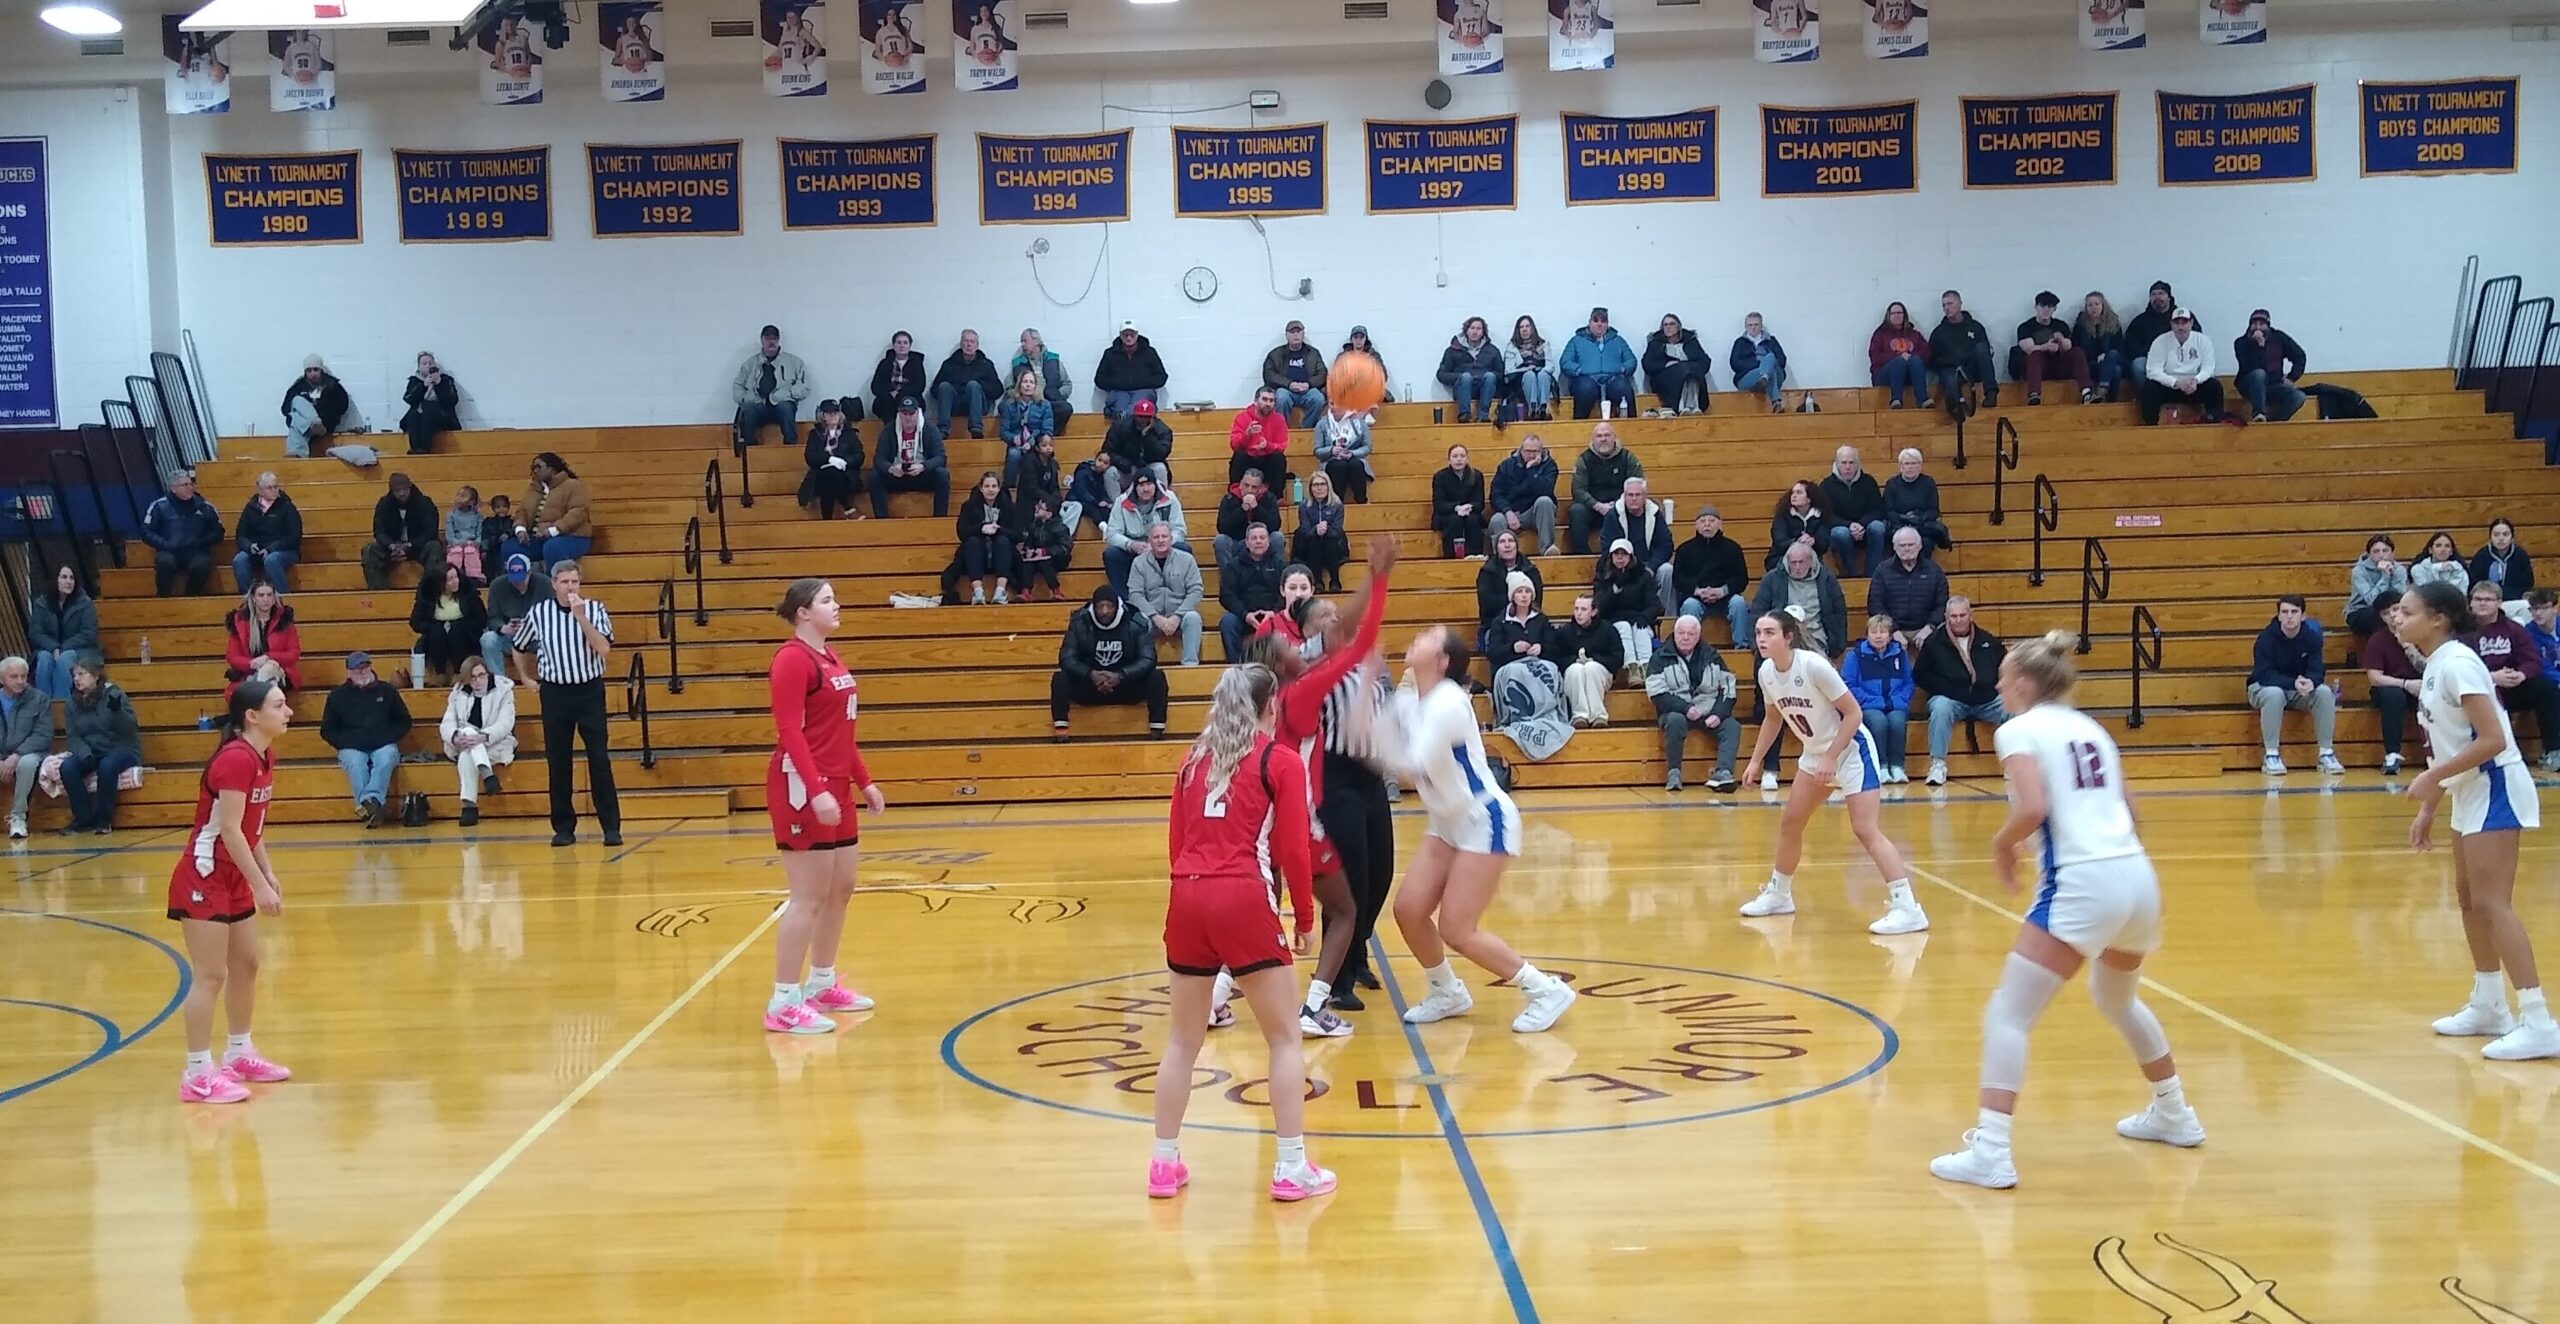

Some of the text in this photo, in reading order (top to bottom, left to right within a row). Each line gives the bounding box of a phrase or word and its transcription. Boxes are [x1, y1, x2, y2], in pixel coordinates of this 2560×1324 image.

[987, 68, 1006, 77] WALSH
[2169, 100, 2303, 120] LYNETT TOURNAMENT
[2373, 91, 2505, 111] LYNETT TOURNAMENT
[1973, 104, 2103, 124] LYNETT TOURNAMENT
[1573, 121, 1704, 140] LYNETT TOURNAMENT
[1772, 114, 1905, 134] LYNETT TOURNAMENT
[2379, 117, 2499, 137] BOYS CHAMPIONS
[1183, 136, 1313, 155] LYNETT TOURNAMENT
[1375, 128, 1506, 148] LYNETT TOURNAMENT
[1980, 131, 2100, 150] CHAMPIONS
[2176, 126, 2298, 146] GIRLS CHAMPIONS
[788, 146, 923, 167] LYNETT TOURNAMENT
[990, 143, 1116, 163] LYNETT TOURNAMENT
[1581, 146, 1701, 166] CHAMPIONS
[1779, 139, 1899, 159] CHAMPIONS
[2418, 143, 2464, 161] 2009
[401, 157, 542, 178] LYNETT TOURNAMENT
[595, 153, 732, 171] LYNETT TOURNAMENT
[1190, 160, 1310, 179] CHAMPIONS
[1381, 154, 1502, 174] CHAMPIONS
[2016, 158, 2063, 175] 2002
[2215, 154, 2261, 172] 2008
[216, 163, 346, 182] LYNETT TOURNAMENT
[996, 167, 1113, 187] CHAMPIONS
[1619, 173, 1664, 190] 1999
[1817, 166, 1861, 184] 2001
[604, 180, 728, 198] CHAMPIONS
[797, 173, 920, 192] CHAMPIONS
[1422, 181, 1462, 198] 1997
[225, 188, 343, 207] CHAMPIONS
[409, 185, 538, 202] CHAMPIONS
[1034, 194, 1077, 210] 1994
[1230, 187, 1272, 203] 1995
[642, 207, 691, 223] 1992
[840, 200, 881, 216] 1993
[264, 216, 307, 232] 1980
[447, 212, 503, 228] 1989
[4, 254, 40, 264] TOOMEY
[15, 286, 42, 296] TALLO
[1, 315, 42, 323] PACEWICZ
[16, 408, 51, 417] HARDING
[2068, 740, 2106, 789] 12
[1203, 780, 1227, 818] 2
